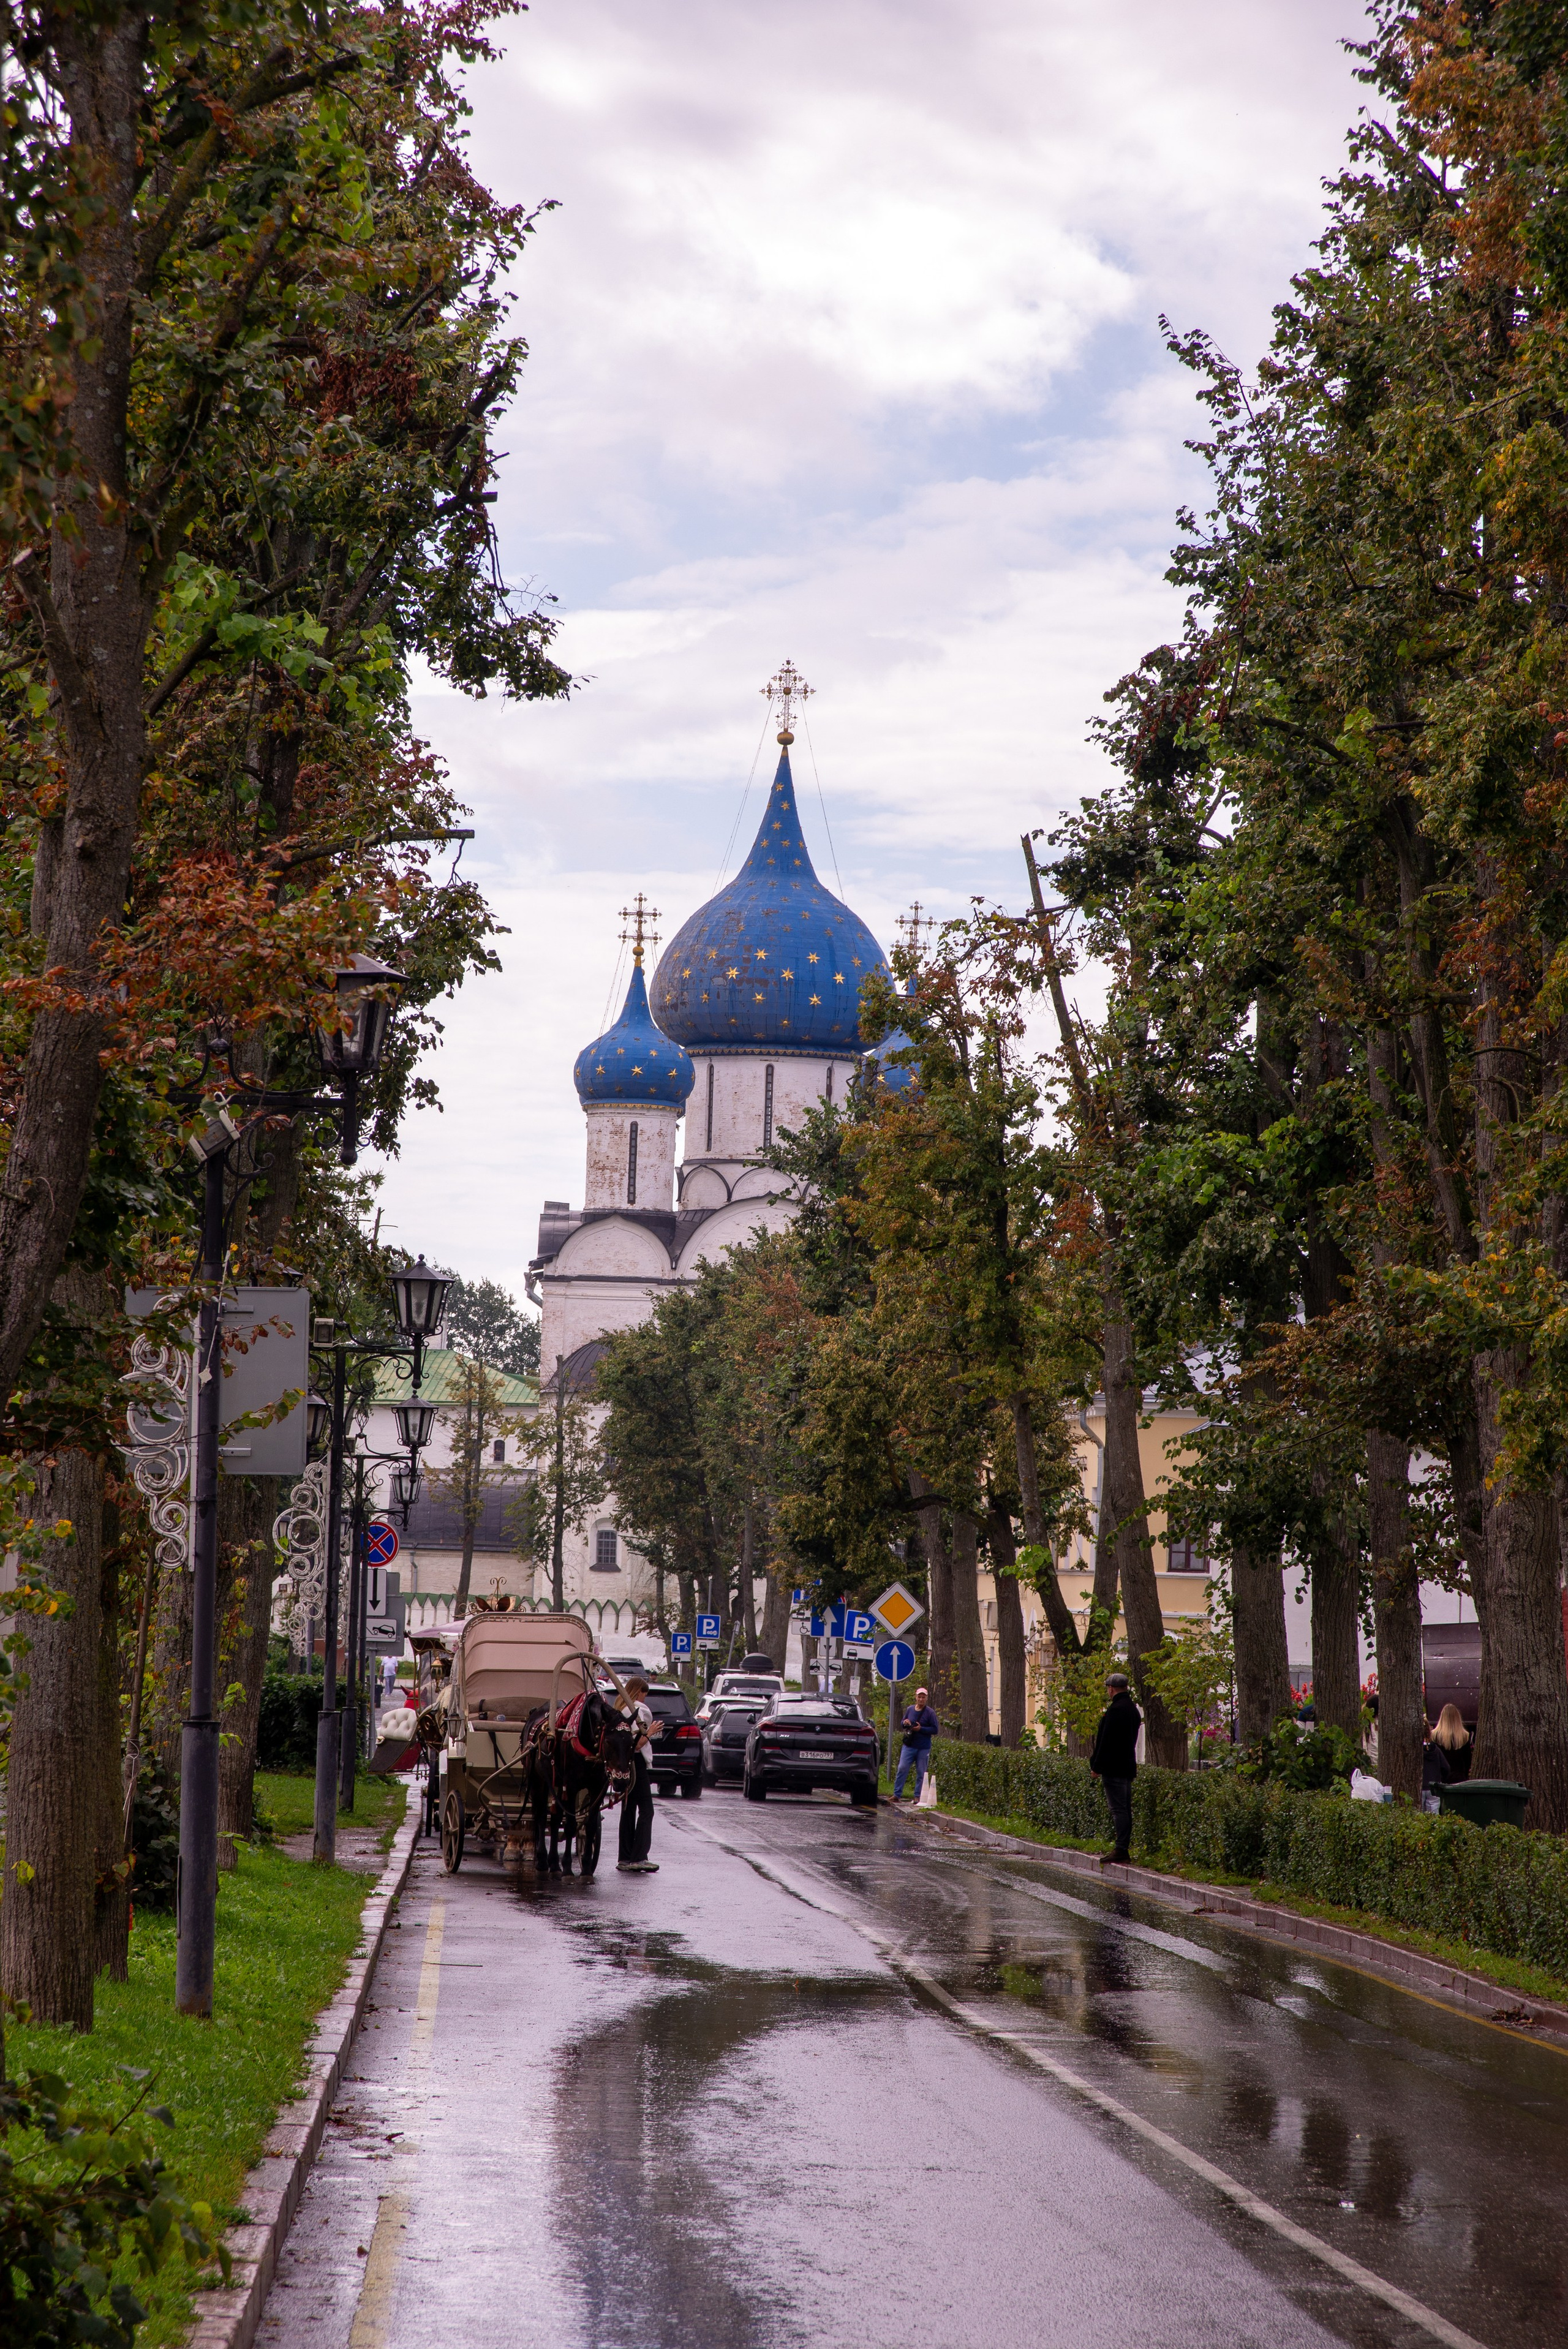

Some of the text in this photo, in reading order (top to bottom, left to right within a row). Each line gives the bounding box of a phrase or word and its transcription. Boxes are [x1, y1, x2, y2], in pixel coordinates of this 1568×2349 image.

[703, 1618, 715, 1635] P
[853, 1616, 870, 1638] P
[676, 1636, 687, 1650] P
